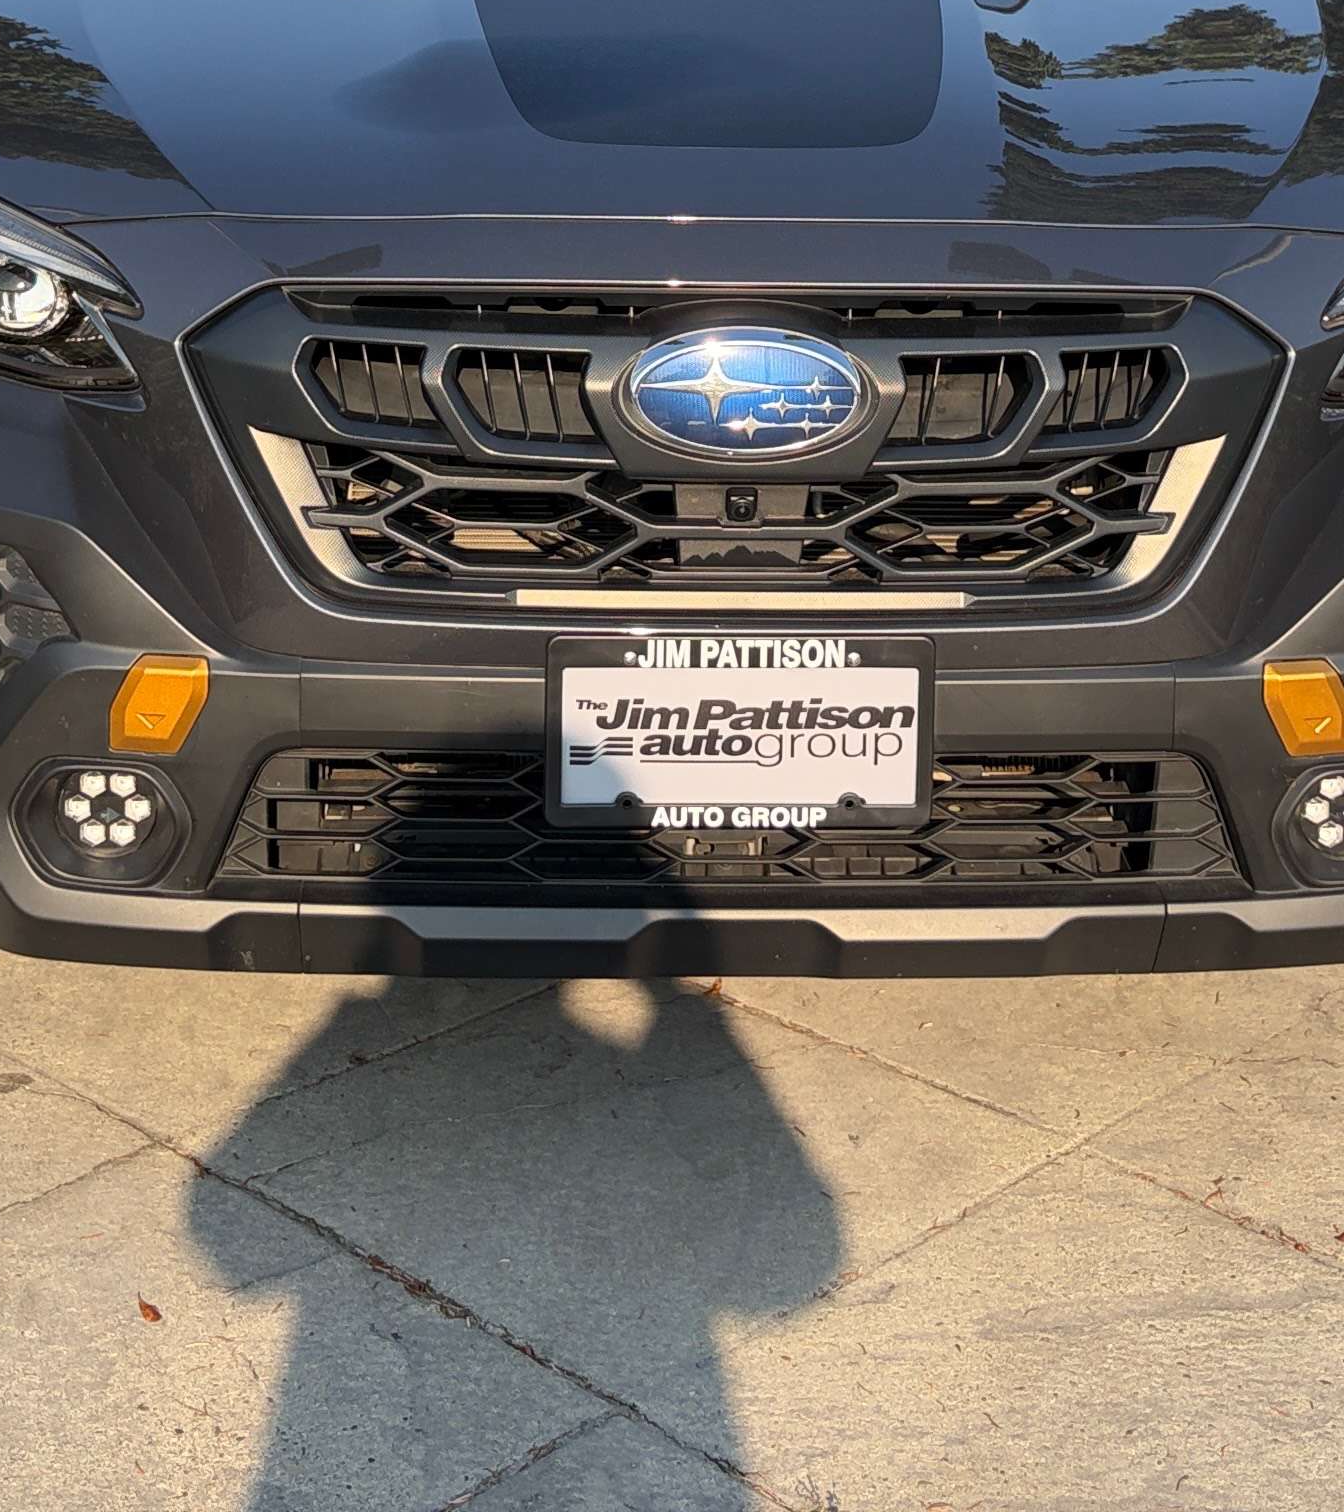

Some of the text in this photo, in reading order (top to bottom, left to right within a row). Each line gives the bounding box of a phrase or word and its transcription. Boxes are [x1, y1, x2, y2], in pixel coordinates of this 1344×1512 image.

[637, 639, 846, 668] JIM PATTISON
[575, 697, 916, 730] The Jim Pattison
[650, 807, 828, 828] AUTO GROUP
